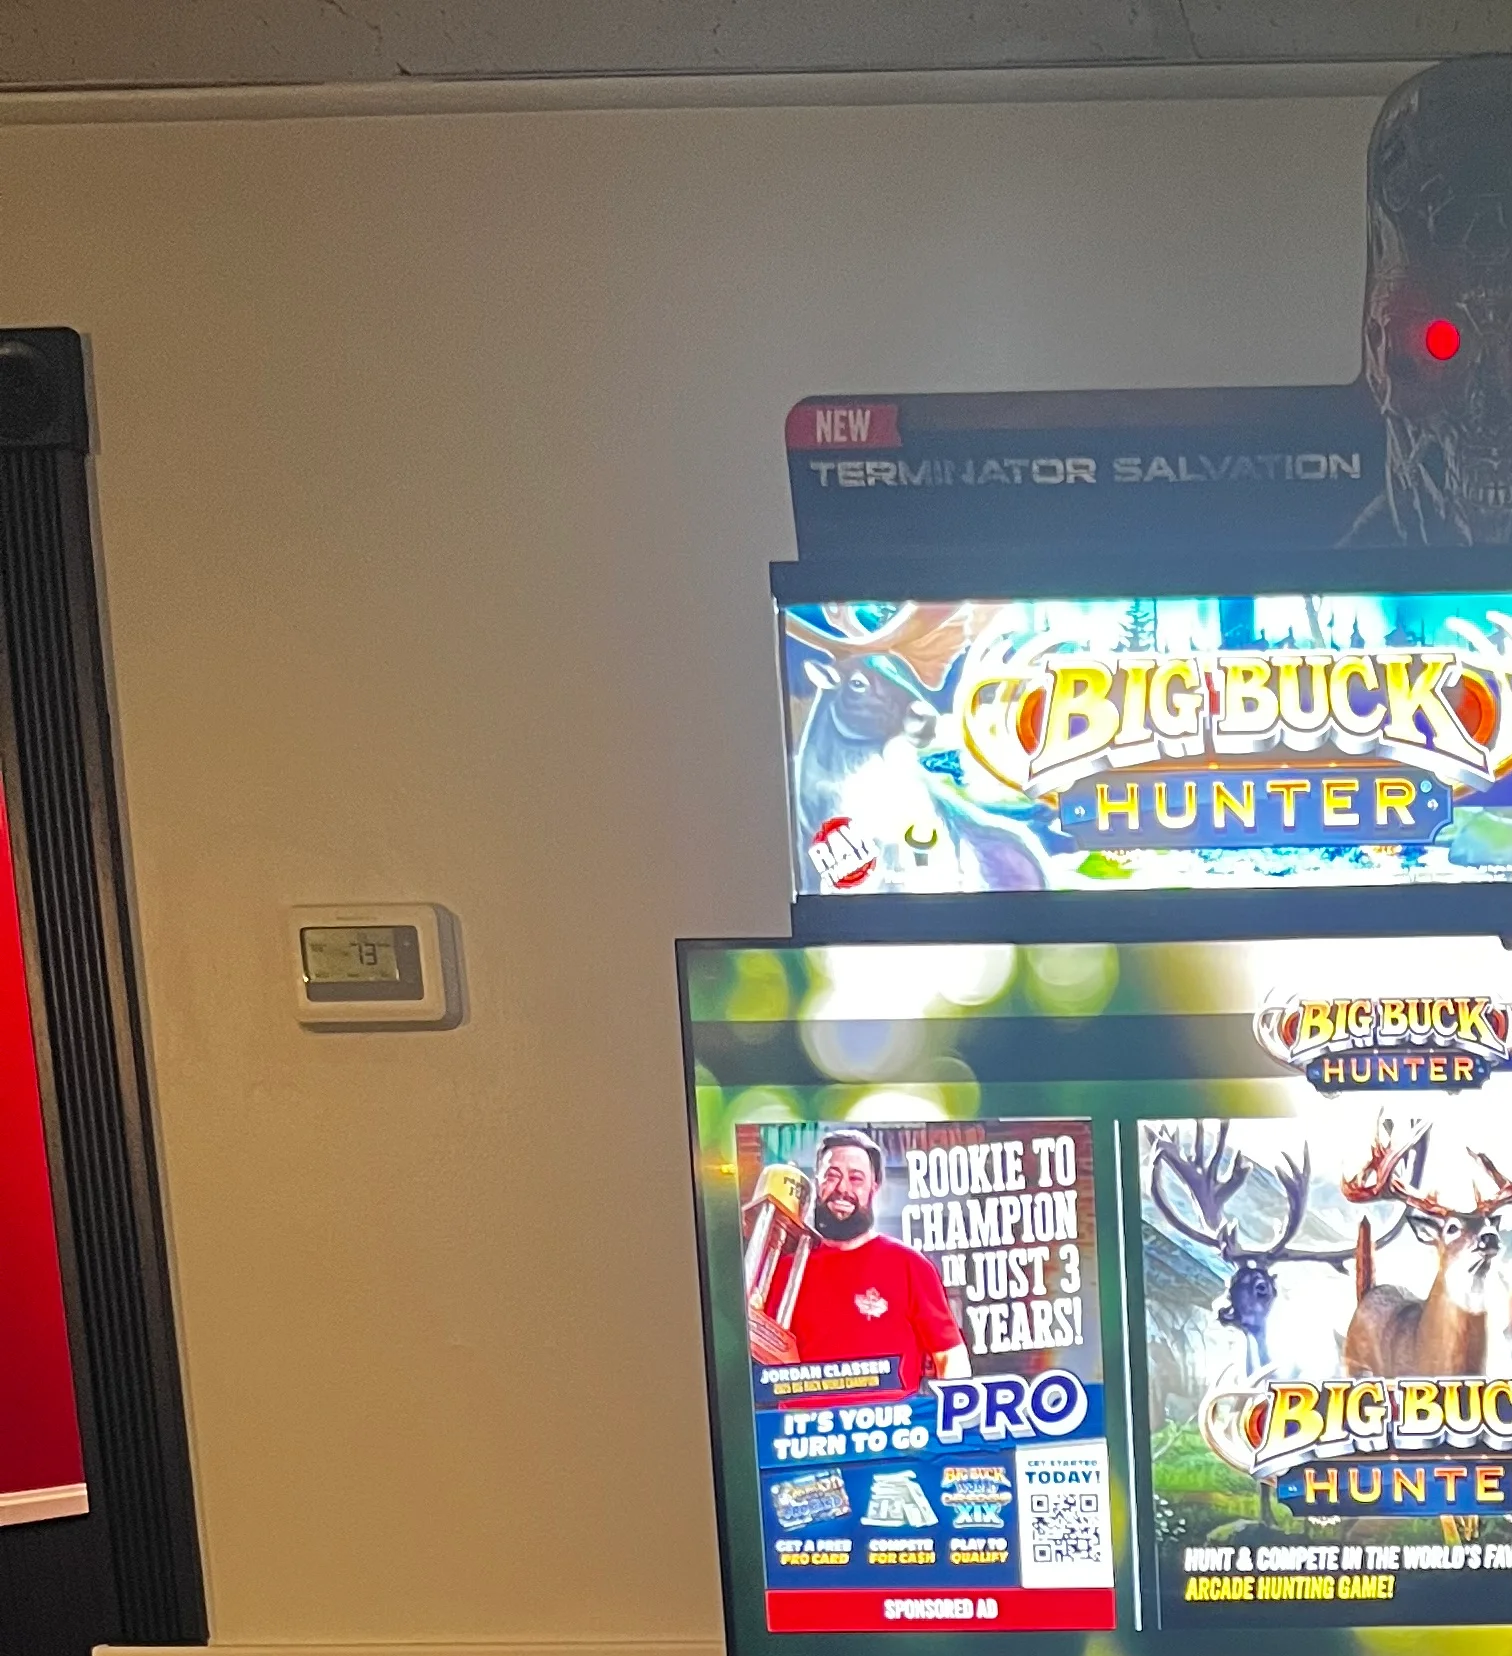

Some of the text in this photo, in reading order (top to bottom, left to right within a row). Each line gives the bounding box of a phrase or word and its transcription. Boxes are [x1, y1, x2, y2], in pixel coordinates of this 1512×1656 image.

[815, 409, 870, 442] NEW
[809, 453, 1362, 488] TERMINATOR SALVATION
[1028, 653, 1494, 780] BIG BUCK
[1096, 778, 1417, 833] HUNTER
[1297, 998, 1374, 1045] BIG
[1376, 997, 1502, 1050] BUCK
[1322, 1055, 1475, 1083] HUNTER
[906, 1135, 1076, 1199] ROOKIE TO
[901, 1190, 1078, 1252] CHAMPION
[943, 1244, 1080, 1300] IN JUST 3
[966, 1297, 1084, 1355] YEARS!
[760, 1360, 891, 1384] JORDAN CLASSEN
[784, 1405, 913, 1436] IT'S YOUR
[930, 1370, 1086, 1441] PRO
[1262, 1380, 1388, 1452] BIG
[773, 1426, 929, 1460] TURN TO GO
[1025, 1470, 1100, 1484] TODAY!
[956, 1503, 1003, 1525] XIX
[898, 1552, 936, 1565] CASH
[951, 1551, 1009, 1564] QUALIFY
[1184, 1547, 1233, 1571] HUNT
[1236, 1548, 1253, 1570] &
[1256, 1546, 1338, 1571] COMPETE
[1342, 1546, 1363, 1570] IN
[1365, 1545, 1400, 1570] THE
[1404, 1544, 1481, 1569] WORLD'S
[1184, 1575, 1396, 1601] ARCADE HUNTING GAME!
[884, 1598, 999, 1620] SPONSORED AD
